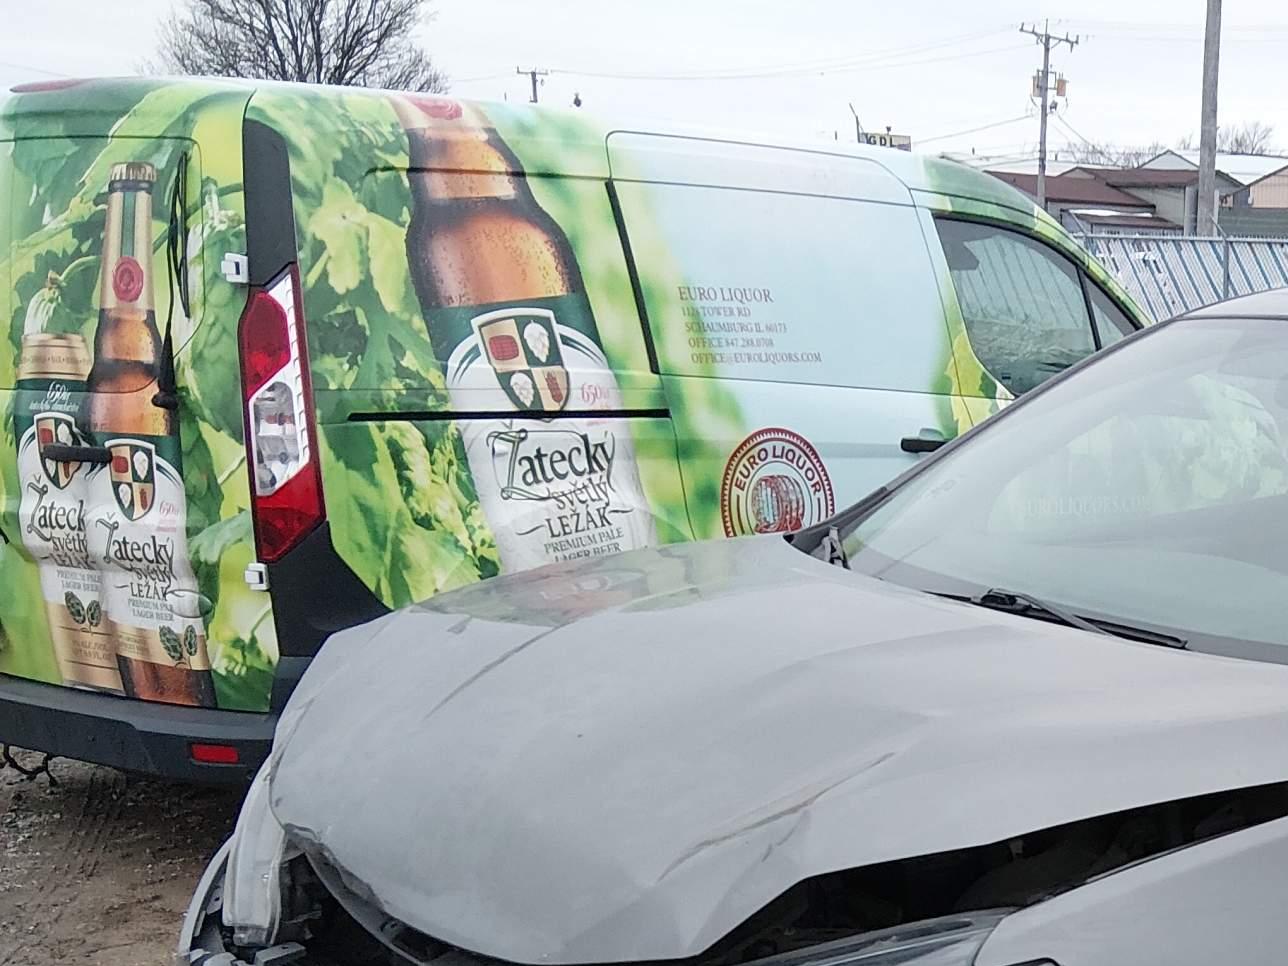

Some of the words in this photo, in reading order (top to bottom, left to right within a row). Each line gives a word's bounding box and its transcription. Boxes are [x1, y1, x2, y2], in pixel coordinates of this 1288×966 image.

[678, 286, 717, 301] EURO
[720, 287, 774, 304] LIQUOR
[702, 306, 735, 317] TOWER
[737, 307, 751, 317] RD
[685, 321, 753, 333] SCHAUMBURG
[755, 322, 765, 333] IL
[688, 337, 725, 348] OFFICE
[734, 447, 769, 492] EURO
[772, 445, 822, 496] LIQUOR
[27, 474, 87, 542] Žateck
[545, 505, 613, 539] LEŽÁK
[544, 533, 598, 554] PREMIUM
[599, 527, 624, 543] PALE
[593, 542, 622, 556] BEER
